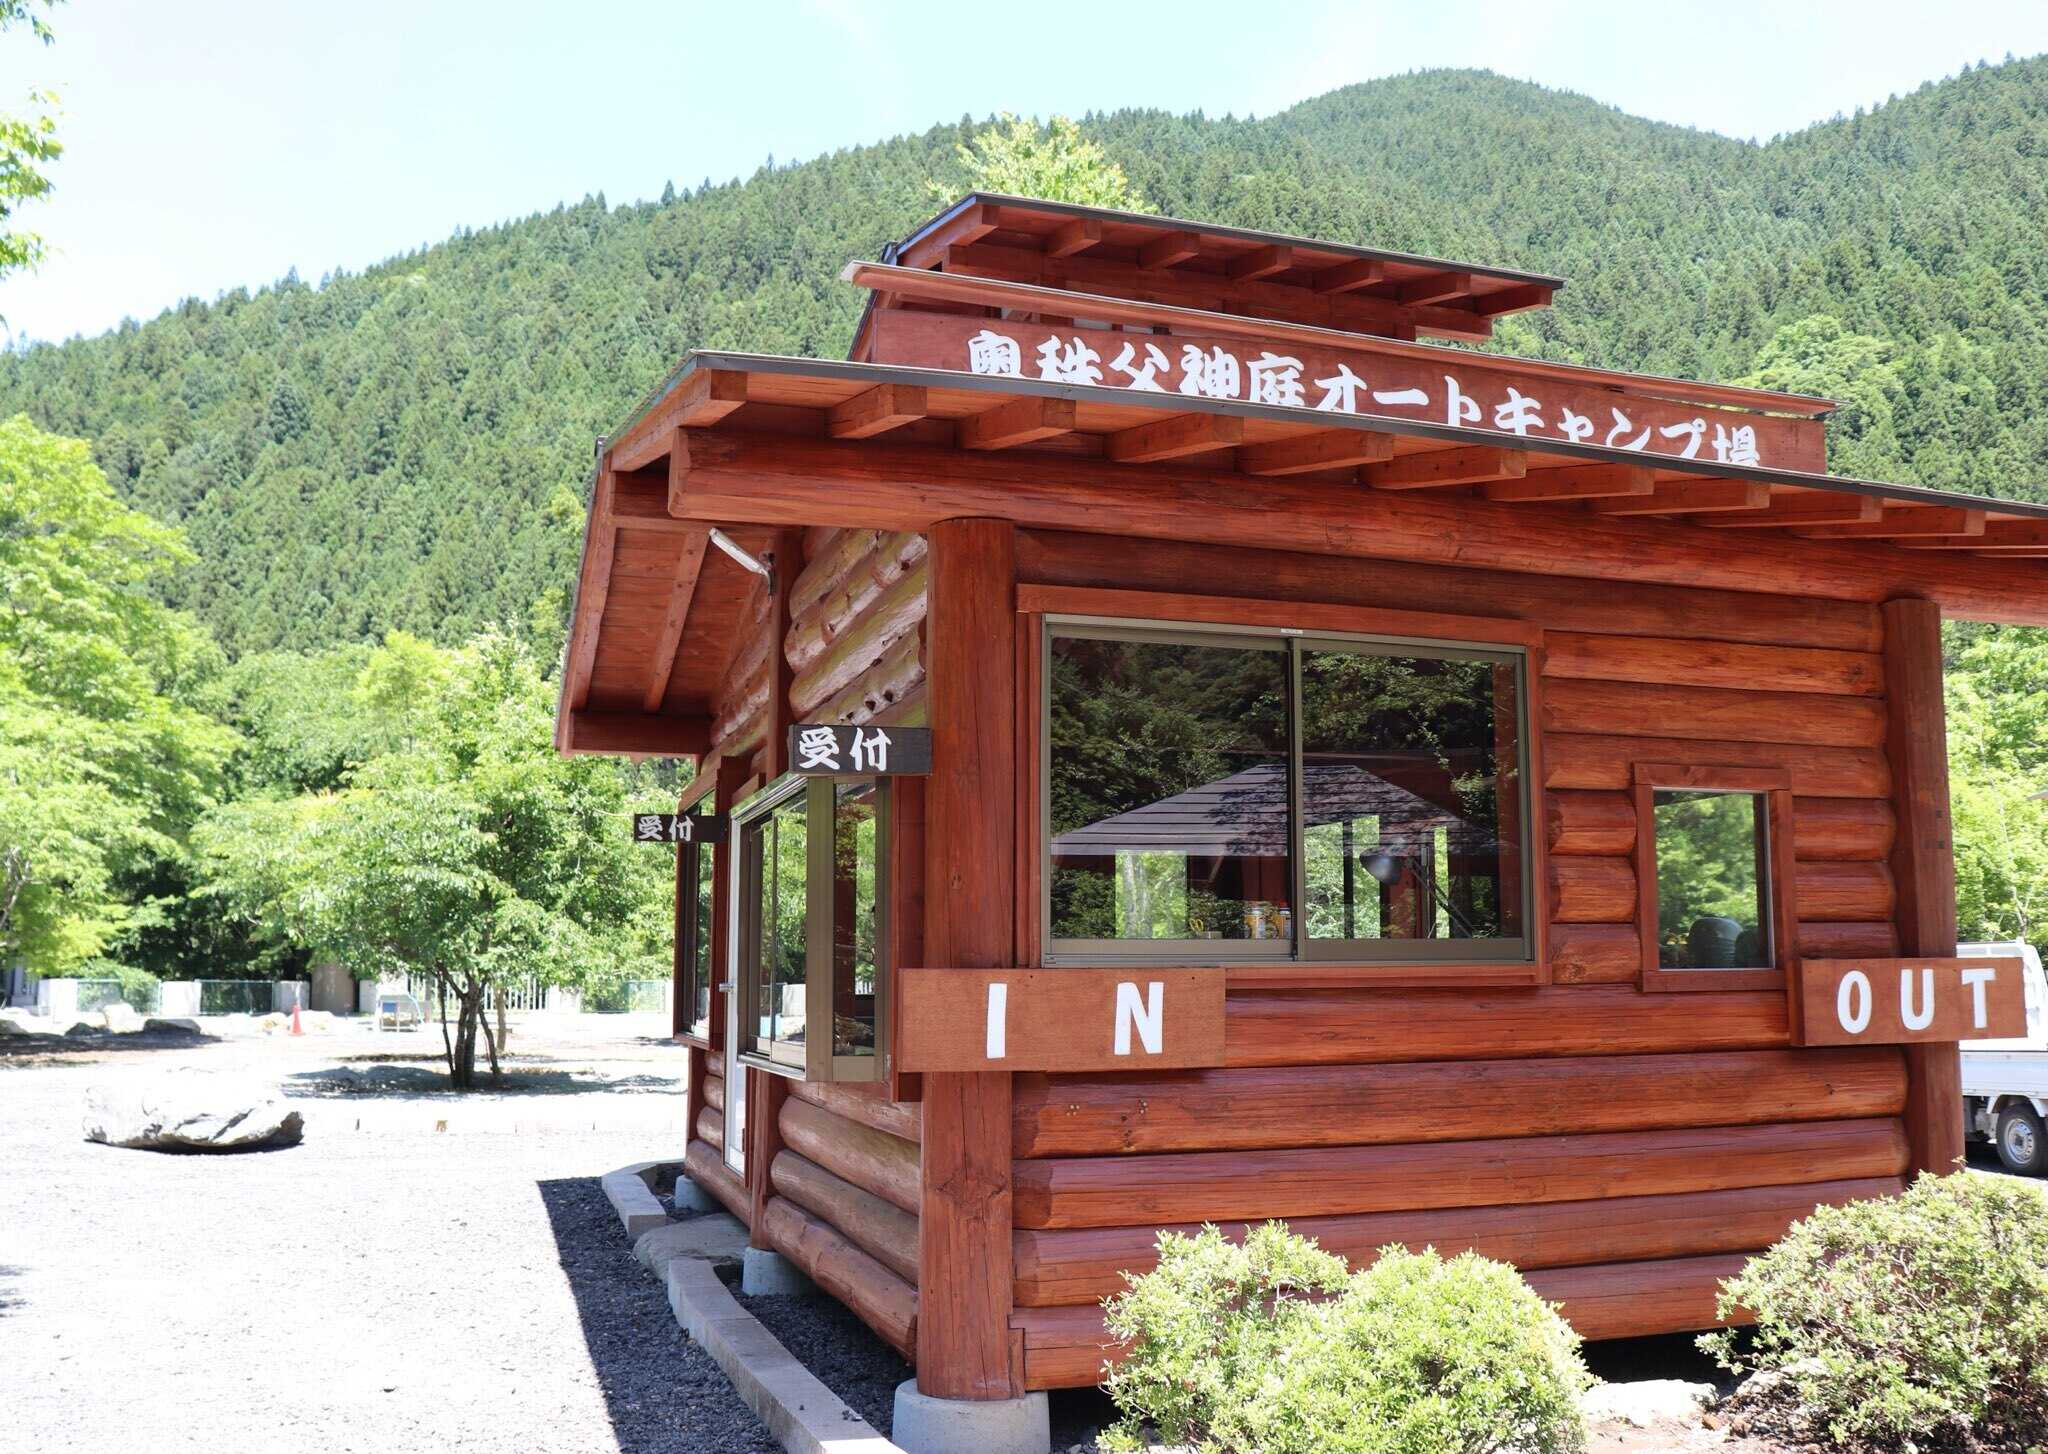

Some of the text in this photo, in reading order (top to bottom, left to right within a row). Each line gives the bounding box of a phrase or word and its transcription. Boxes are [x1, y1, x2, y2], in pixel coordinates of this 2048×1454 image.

[799, 726, 892, 771] 受付
[638, 815, 694, 841] 受付
[986, 981, 1164, 1059] IN
[1837, 968, 1996, 1034] OUT
